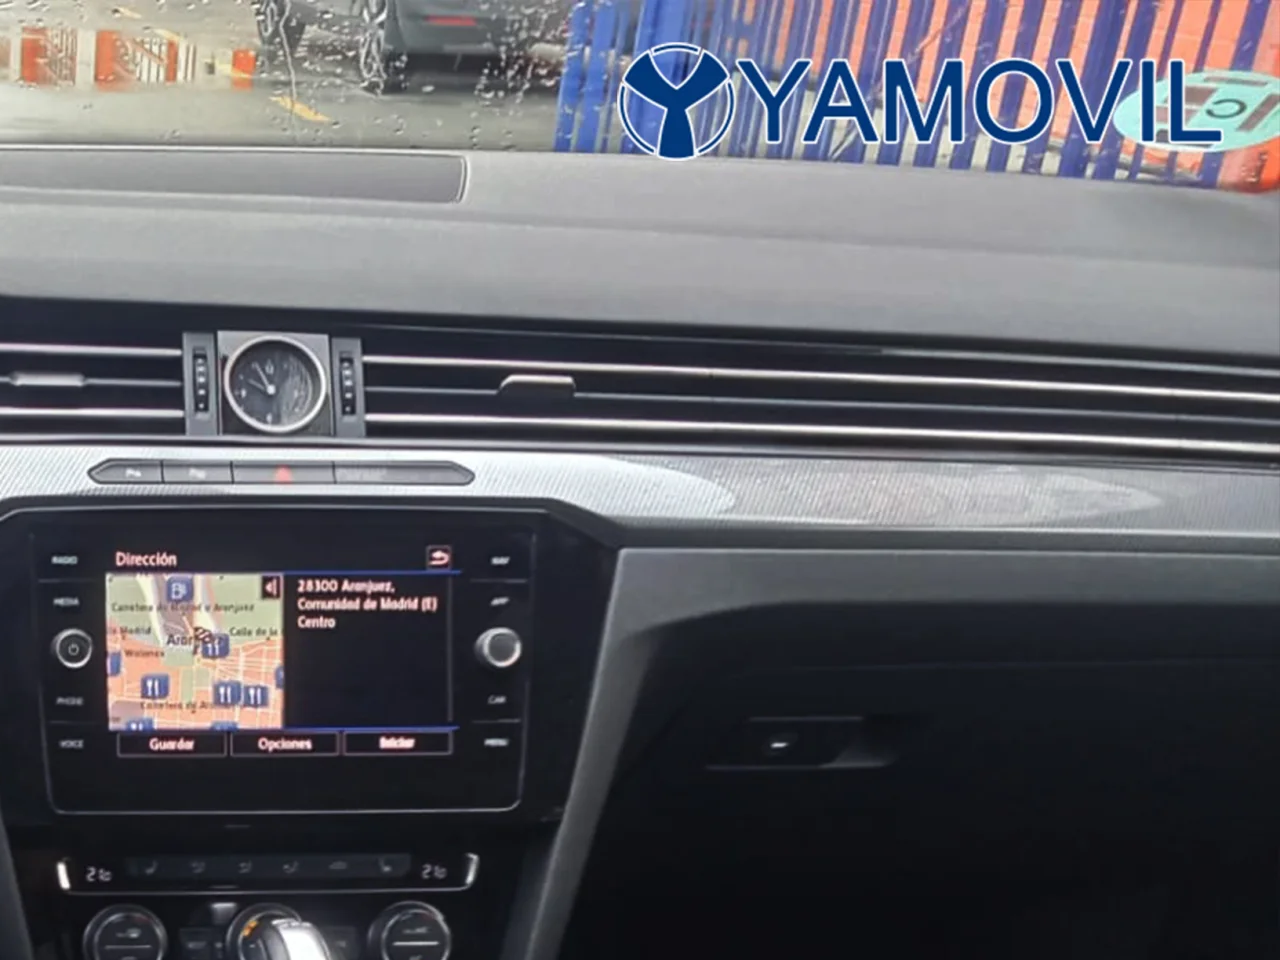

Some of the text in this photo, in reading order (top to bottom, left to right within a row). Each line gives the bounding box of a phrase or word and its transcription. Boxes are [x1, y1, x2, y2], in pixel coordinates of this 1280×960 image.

[115, 551, 178, 568] Dirección
[297, 579, 339, 593] 28300
[297, 597, 361, 611] Comunidad
[363, 598, 377, 611] de
[380, 596, 419, 611] Madrid
[297, 615, 337, 629] Centro
[149, 737, 196, 751] Guardar
[258, 737, 313, 752] Opciones
